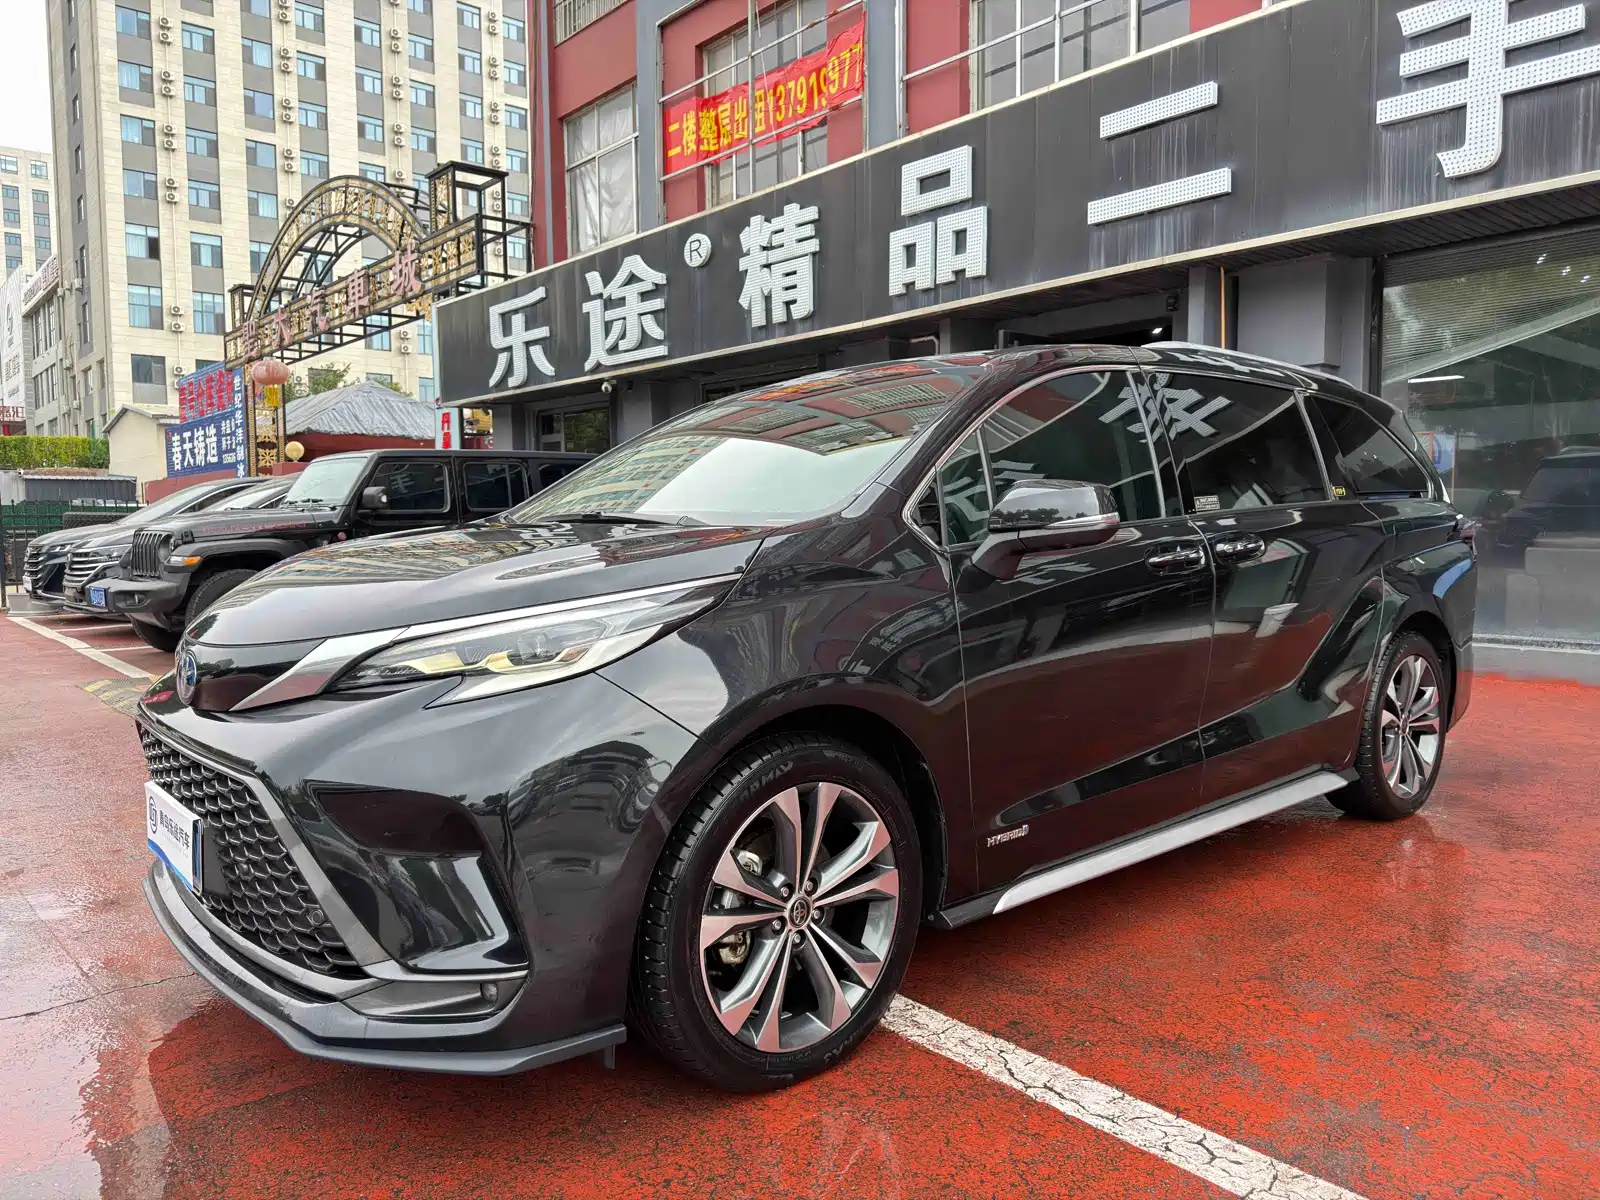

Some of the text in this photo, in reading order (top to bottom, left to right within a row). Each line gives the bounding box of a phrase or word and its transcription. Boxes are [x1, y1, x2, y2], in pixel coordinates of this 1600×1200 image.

[172, 424, 218, 471] 春天铸造
[987, 824, 1030, 848] HYBRID
